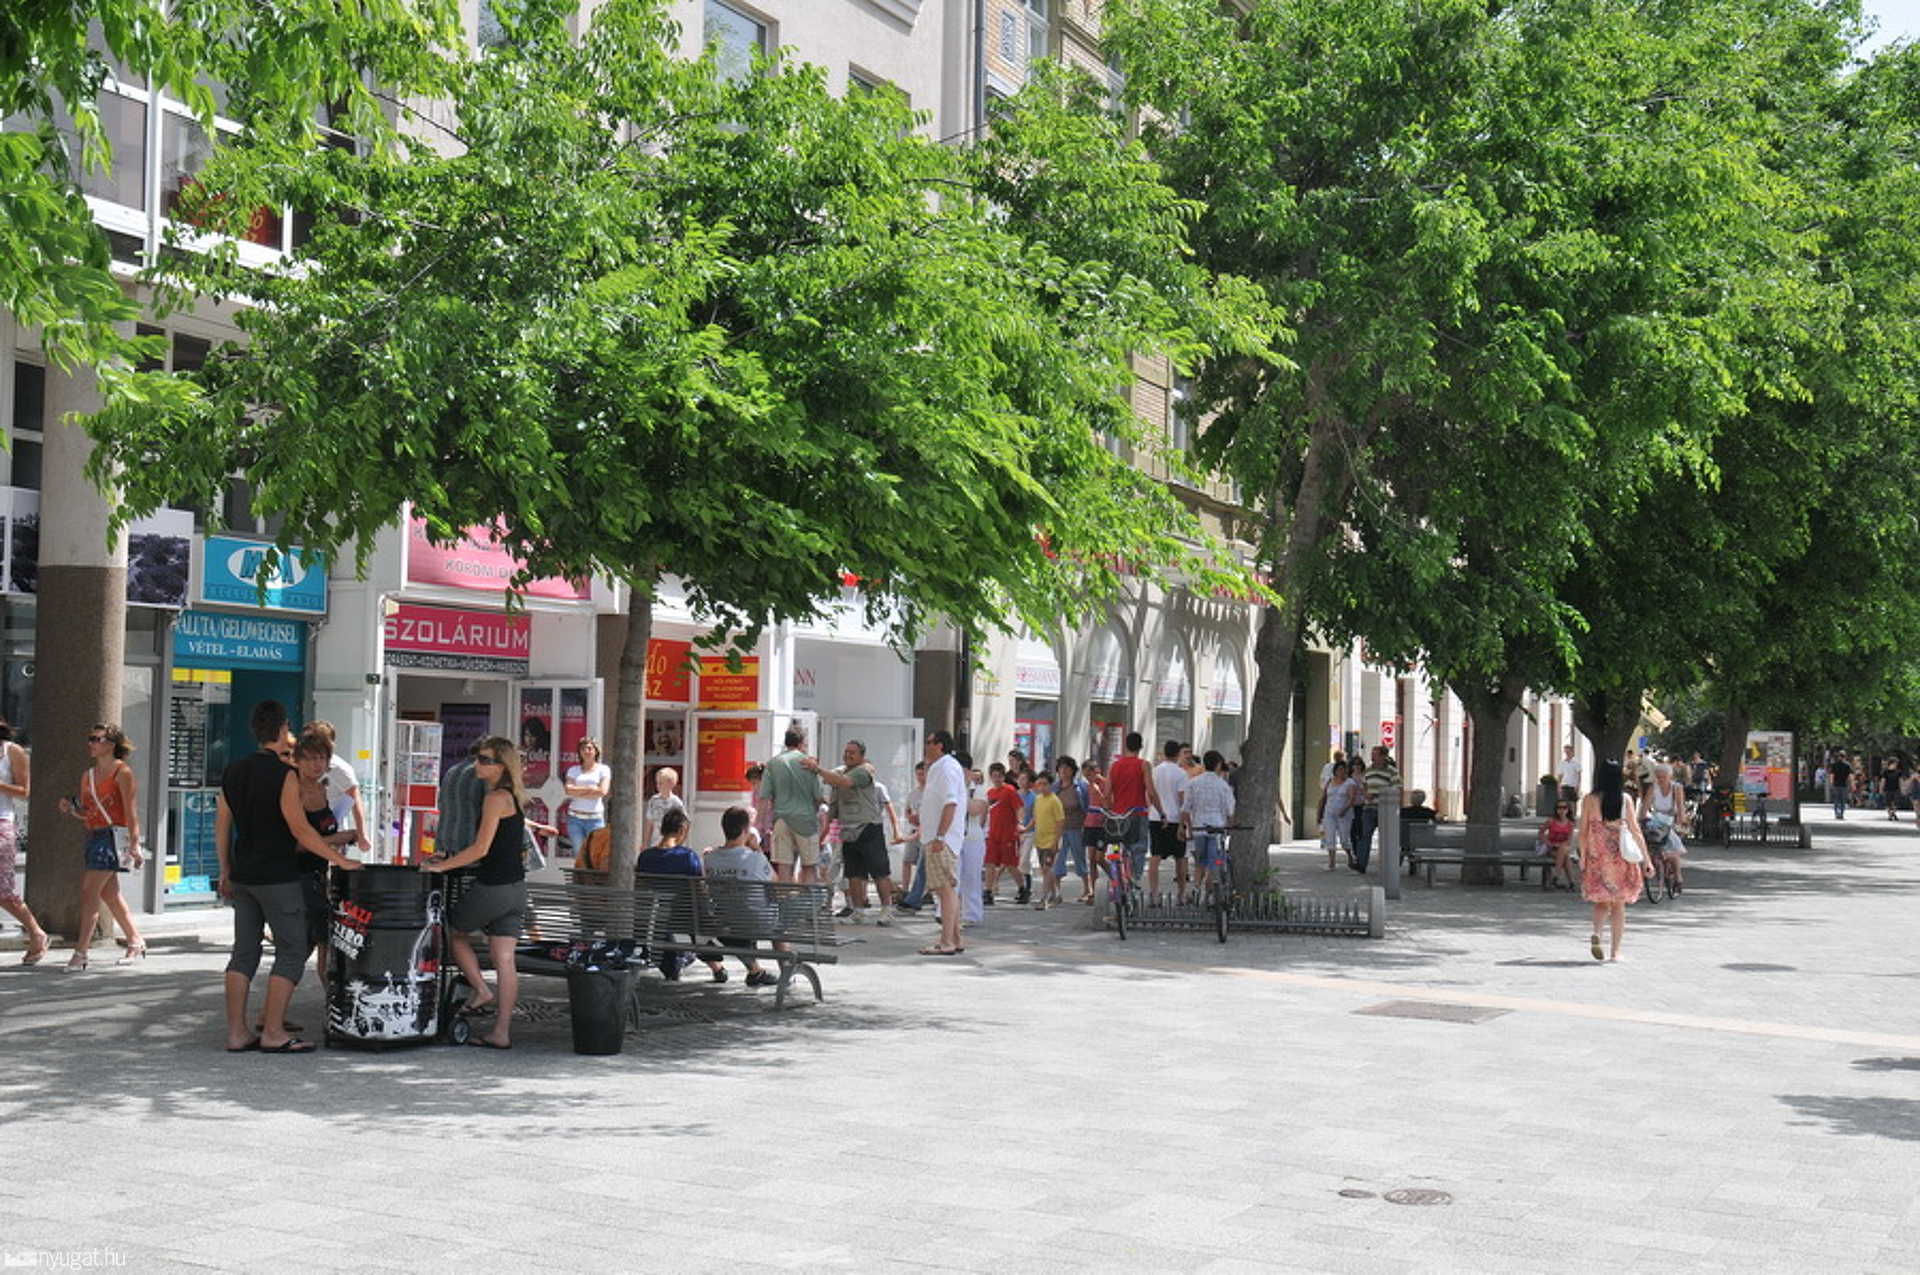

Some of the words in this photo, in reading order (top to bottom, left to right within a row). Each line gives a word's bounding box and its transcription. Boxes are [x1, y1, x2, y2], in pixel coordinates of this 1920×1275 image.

[384, 616, 528, 650] SZOLÁRIUM
[188, 640, 227, 656] VÉTEL
[237, 643, 283, 660] ELADÁS
